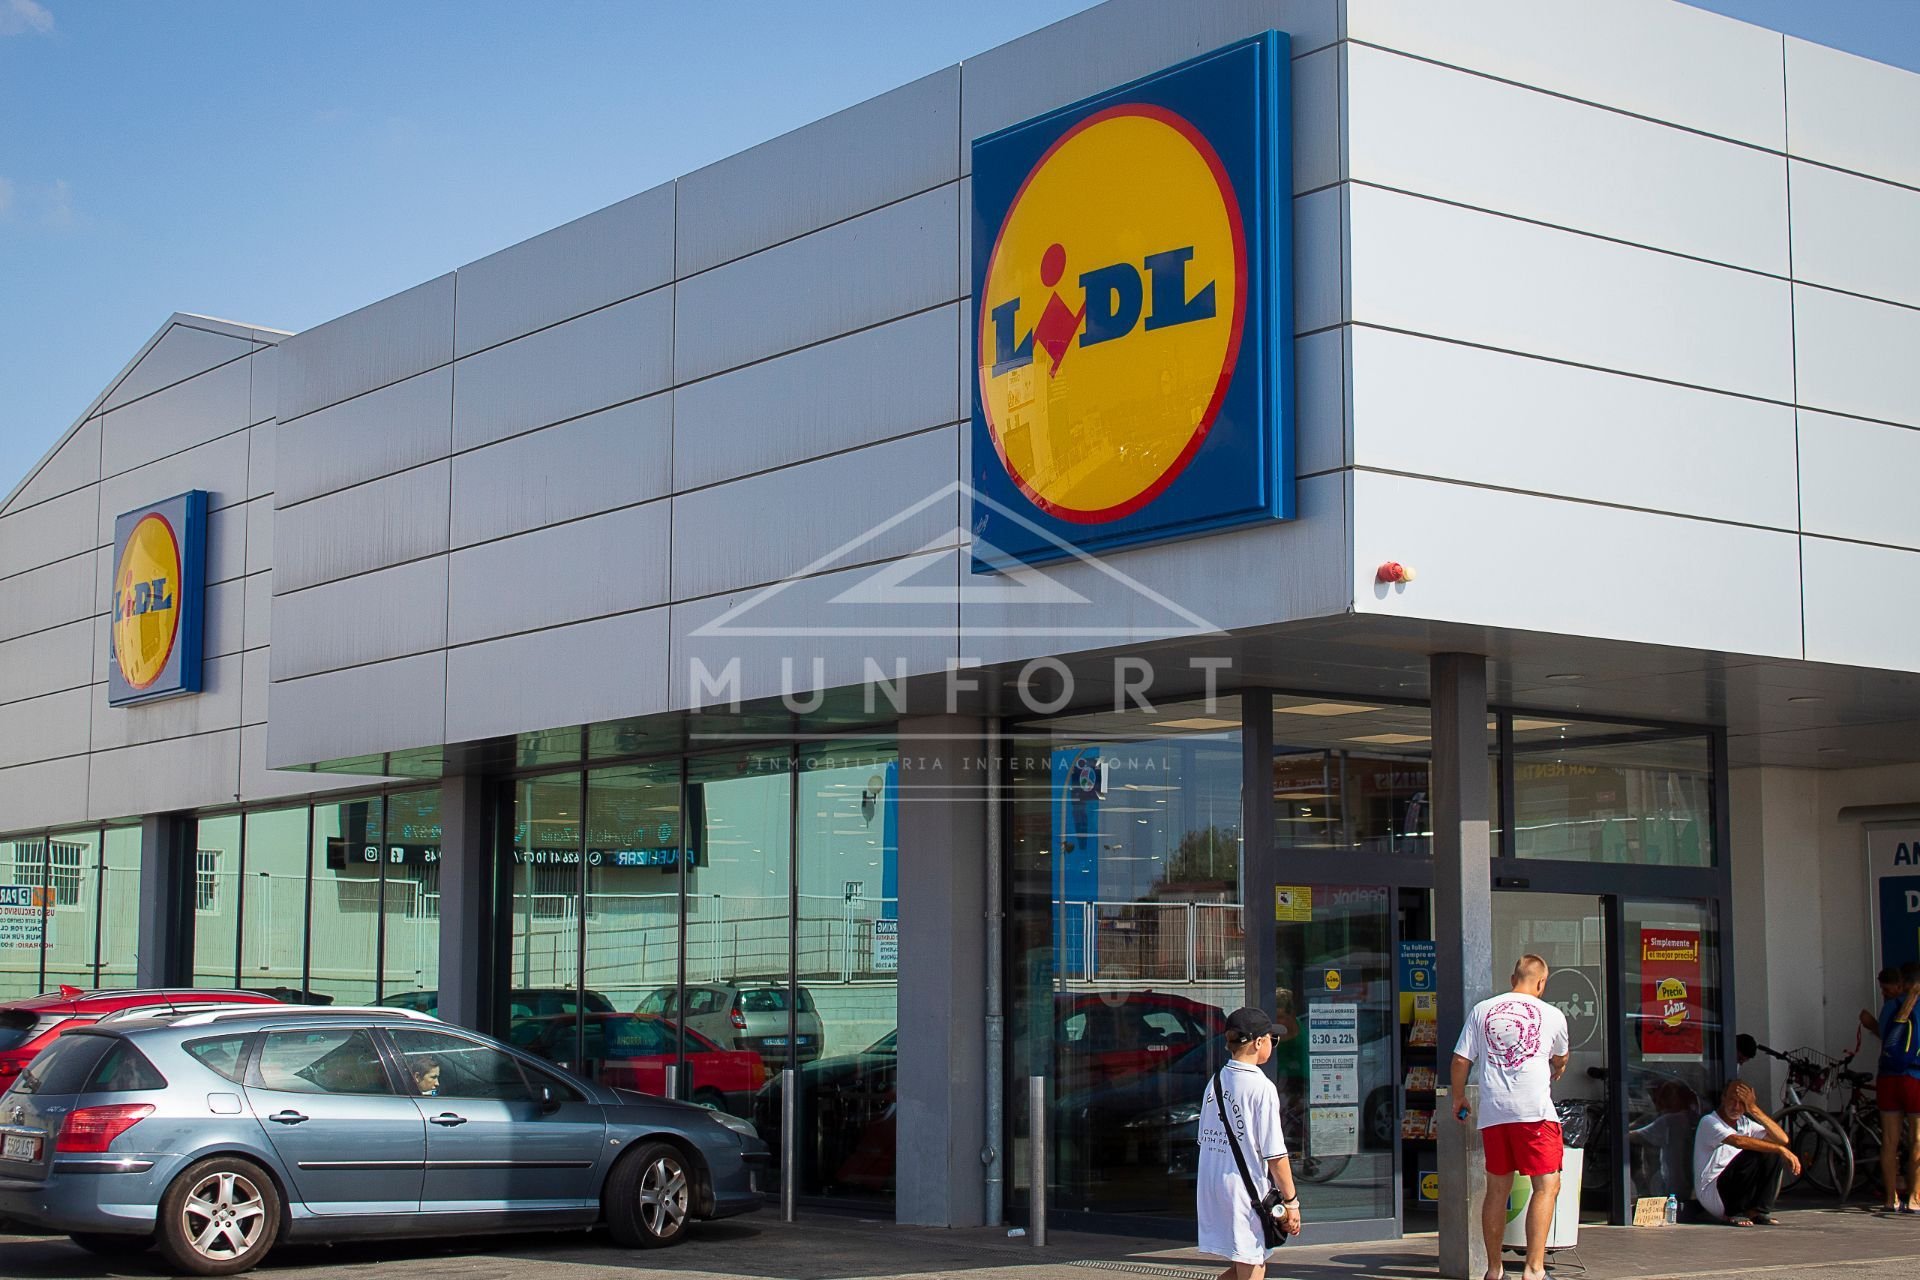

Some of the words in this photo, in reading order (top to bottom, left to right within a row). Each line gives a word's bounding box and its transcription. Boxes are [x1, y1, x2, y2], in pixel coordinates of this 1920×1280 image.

[1662, 986, 1683, 998] Precio
[1312, 1034, 1331, 1044] 8:30
[1332, 1036, 1338, 1044] a
[1339, 1034, 1355, 1044] 22h
[1223, 1090, 1245, 1141] ELIGION
